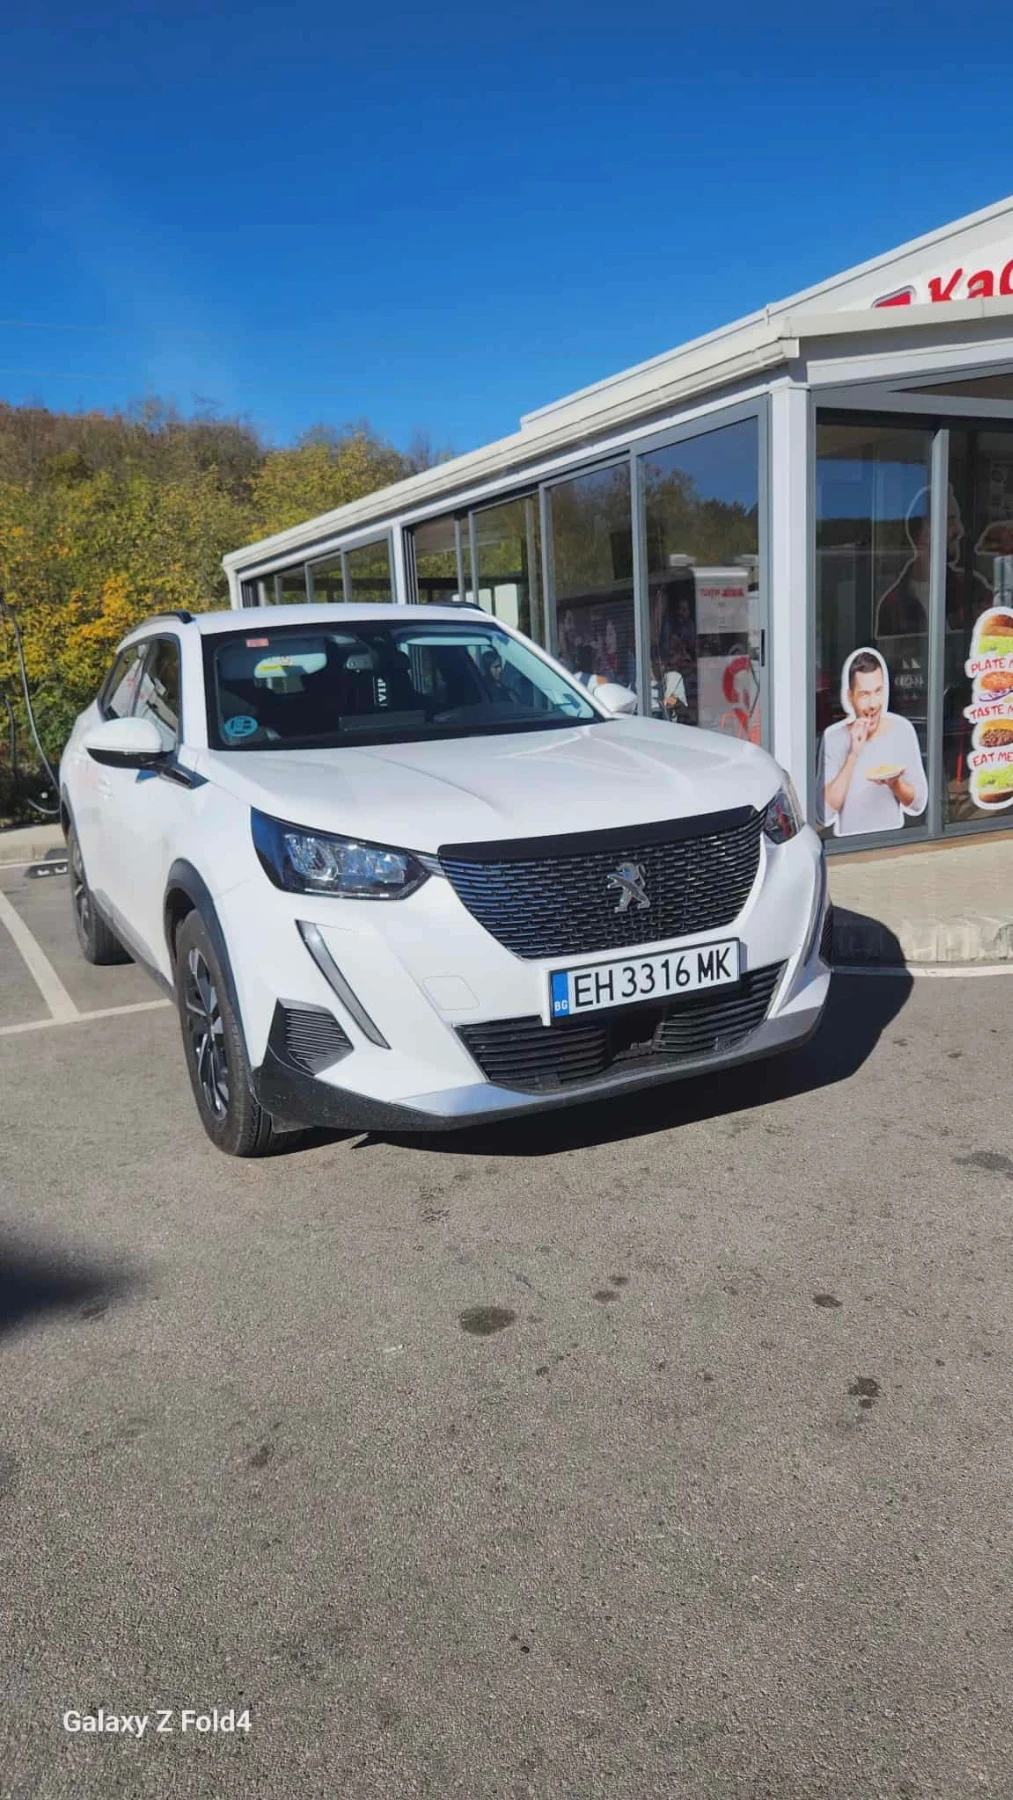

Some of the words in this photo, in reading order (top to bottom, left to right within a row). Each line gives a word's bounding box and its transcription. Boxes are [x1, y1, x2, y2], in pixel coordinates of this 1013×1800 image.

[971, 657, 1006, 674] PLATE
[969, 704, 1004, 719] TASTE
[973, 752, 995, 767] EAT
[574, 969, 614, 1007] EH
[621, 955, 690, 998] 3316
[698, 947, 731, 983] MK
[554, 1000, 568, 1012] BG
